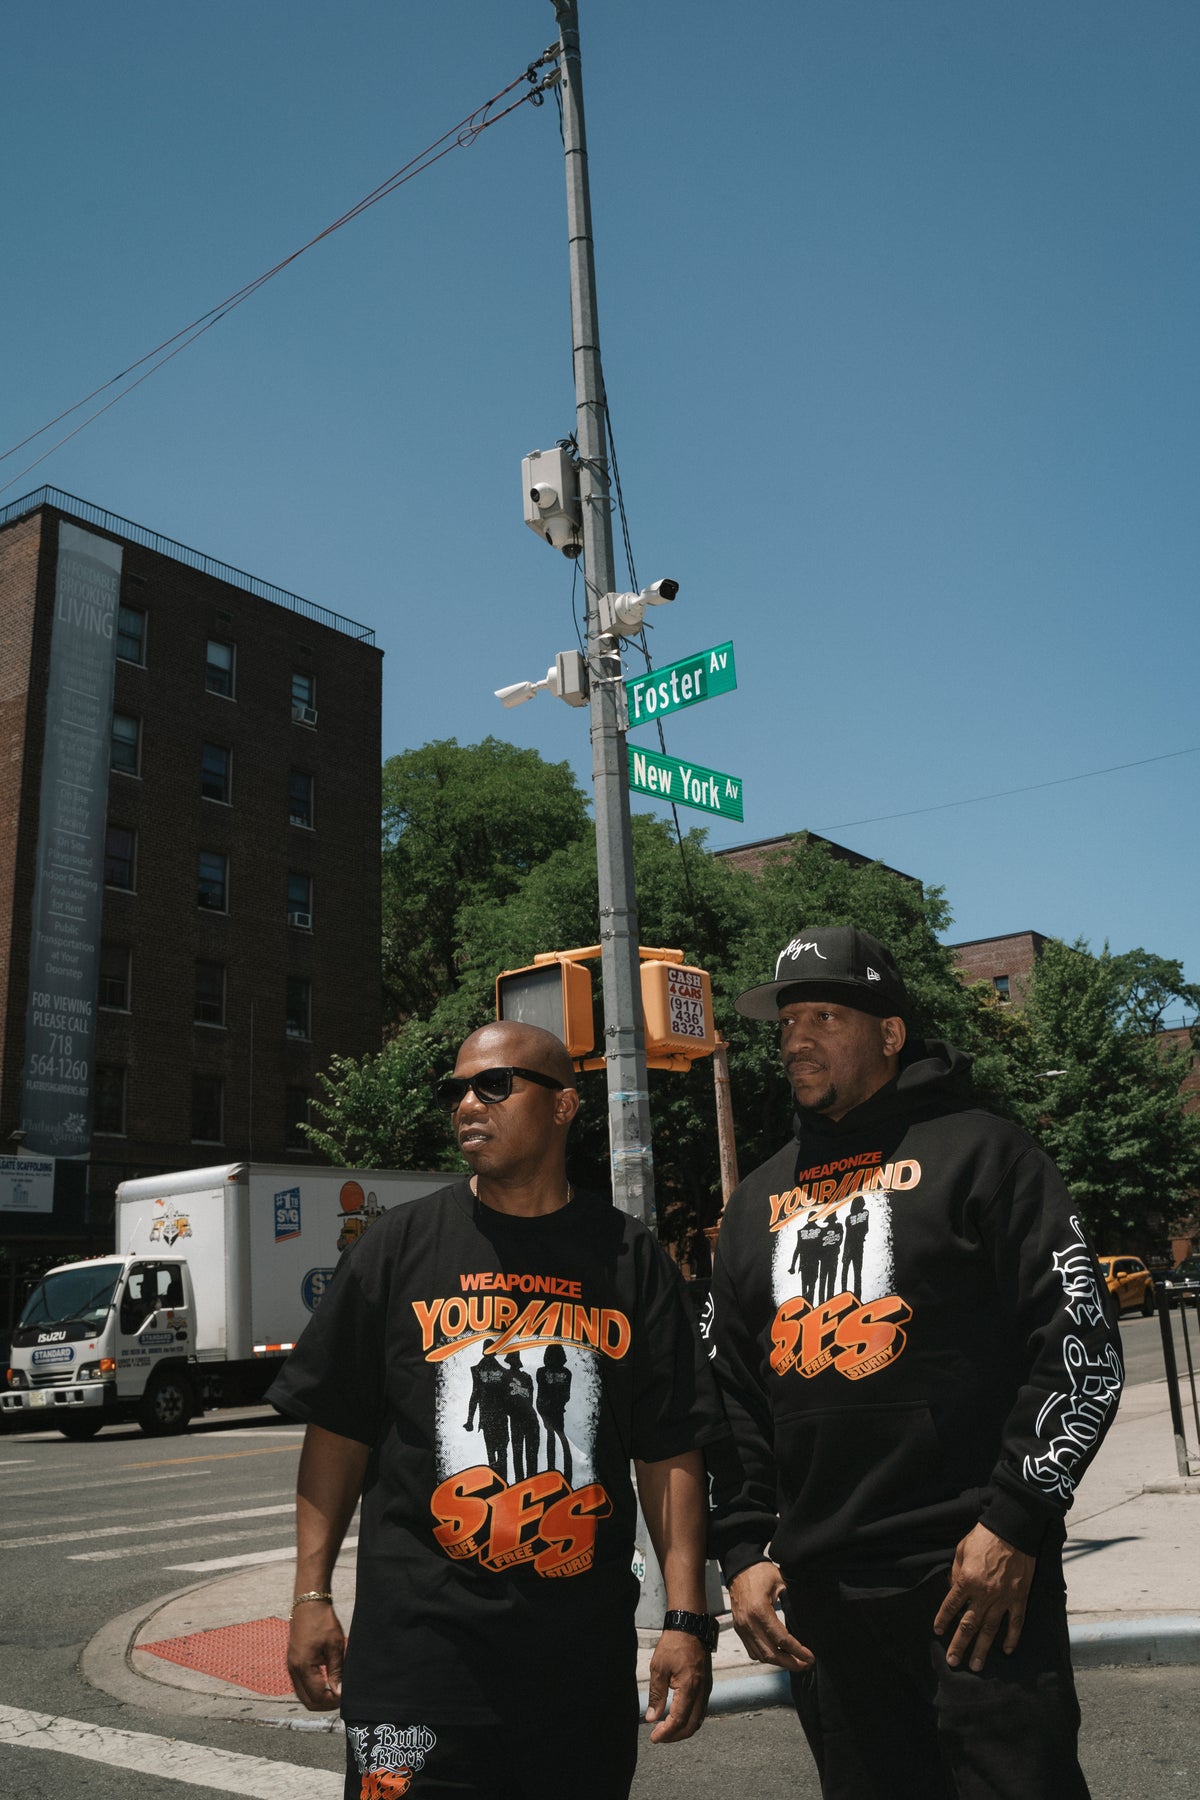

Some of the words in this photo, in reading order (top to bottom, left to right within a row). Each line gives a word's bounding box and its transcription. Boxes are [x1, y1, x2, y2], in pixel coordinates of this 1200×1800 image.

[59, 558, 118, 593] AFFORDABLE
[59, 574, 115, 611] BROOKLYN
[58, 593, 113, 641] LIVING
[634, 668, 703, 719] Foster
[710, 651, 727, 674] Av
[634, 753, 672, 794] New
[679, 766, 721, 809] York
[725, 779, 738, 799] Av
[49, 848, 93, 867] Playground
[36, 930, 95, 953] Transportation
[55, 921, 80, 936] Public
[45, 962, 84, 981] Doorstep
[61, 952, 80, 964] Your
[33, 992, 51, 1009] FOR
[54, 995, 92, 1017] VIEWING
[670, 983, 677, 995] 4
[678, 984, 702, 1000] CARS
[670, 997, 703, 1018] (917)
[675, 1010, 700, 1025] 436
[34, 1011, 67, 1031] PLEASE
[68, 1016, 90, 1034] CALL
[672, 1021, 705, 1037] 8323
[49, 1033, 73, 1056] 718
[29, 1054, 88, 1081] 564-1260
[17, 1161, 53, 1172] SCAFFOLDING
[799, 1151, 883, 1182] WEAPONIZE
[769, 1179, 838, 1226] YOUR
[811, 1159, 921, 1219] MIND
[460, 1272, 583, 1299] WEAPONIZE
[38, 1331, 68, 1343] ISUZU
[412, 1296, 519, 1352] YOUR
[486, 1299, 632, 1361] MIND
[770, 1291, 913, 1381] SFS
[35, 1348, 71, 1359] STANDARD
[804, 1350, 833, 1375] FREE
[846, 1345, 895, 1378] STURDY
[430, 1465, 613, 1573] SFS
[447, 1537, 478, 1557] SAFE
[493, 1543, 535, 1568] FREE
[374, 1723, 437, 1753] Build
[369, 1745, 426, 1775] Block
